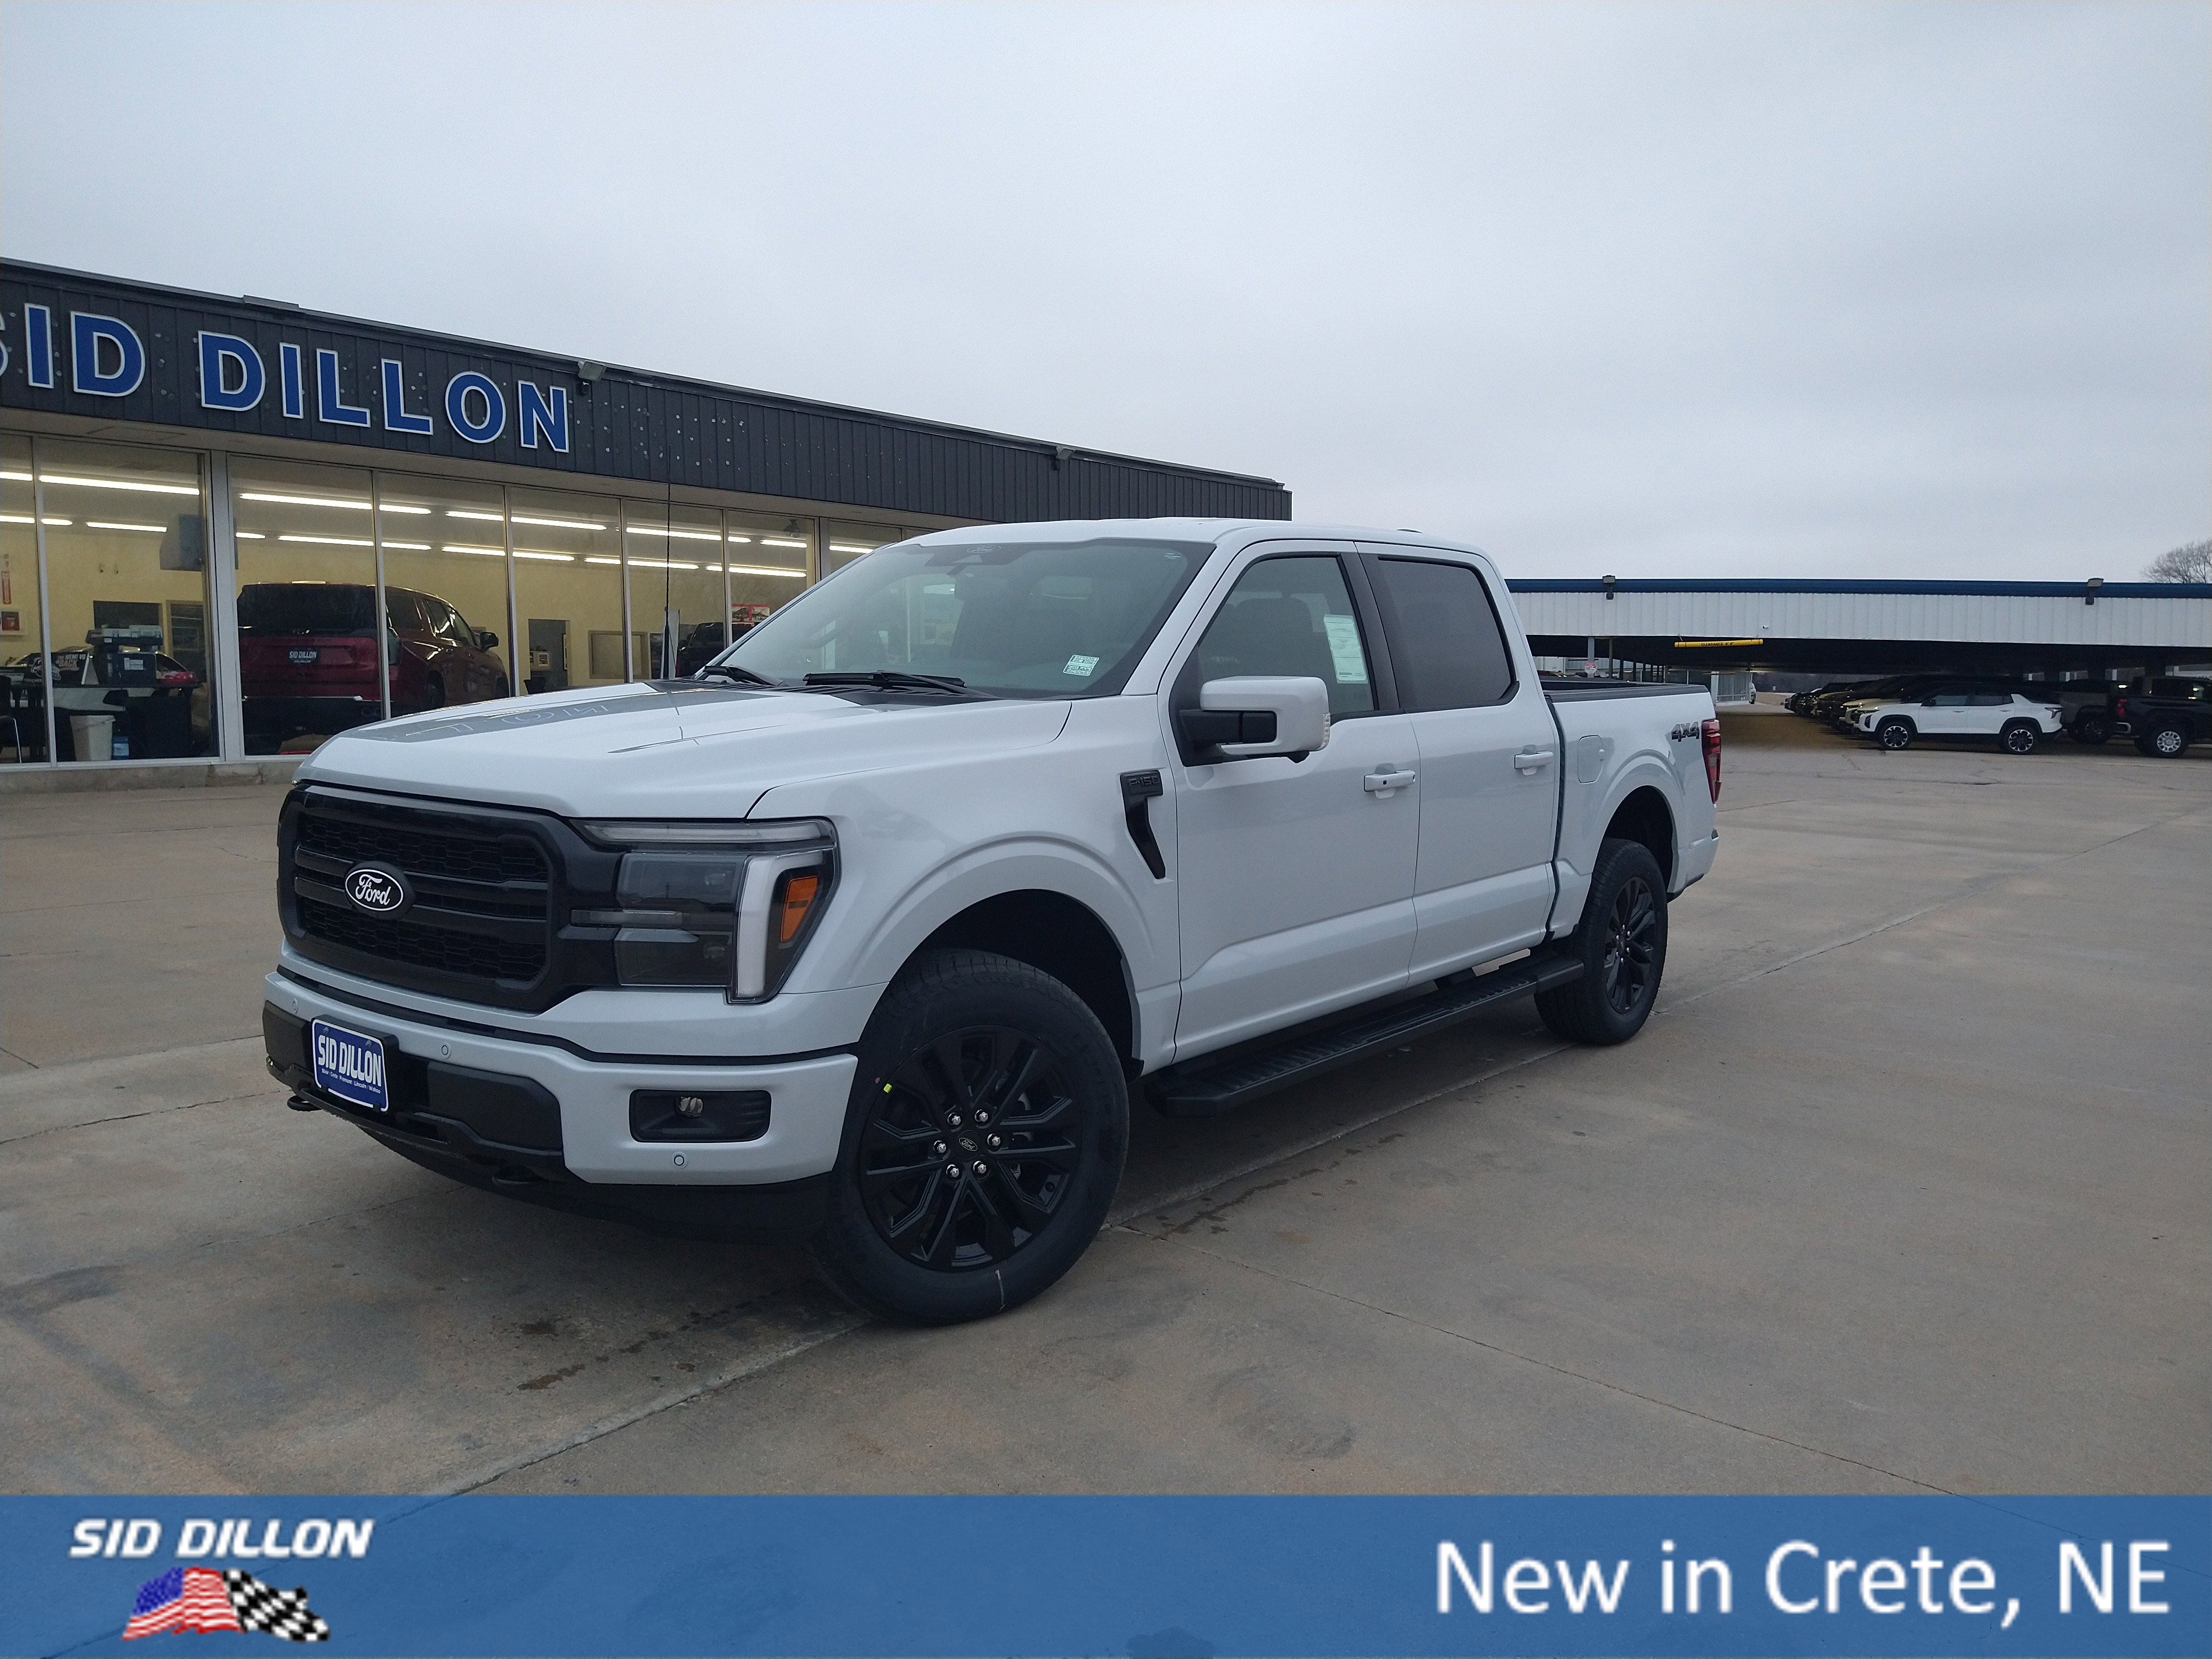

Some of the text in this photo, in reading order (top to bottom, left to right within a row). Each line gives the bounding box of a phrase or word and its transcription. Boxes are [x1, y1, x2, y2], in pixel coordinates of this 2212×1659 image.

[198, 330, 569, 453] DILLON
[1129, 775, 1161, 785] F-150
[355, 874, 392, 905] Ford
[318, 1035, 382, 1087] SID DILLON
[354, 1081, 367, 1089] Lincoln
[961, 1139, 975, 1150] Ford
